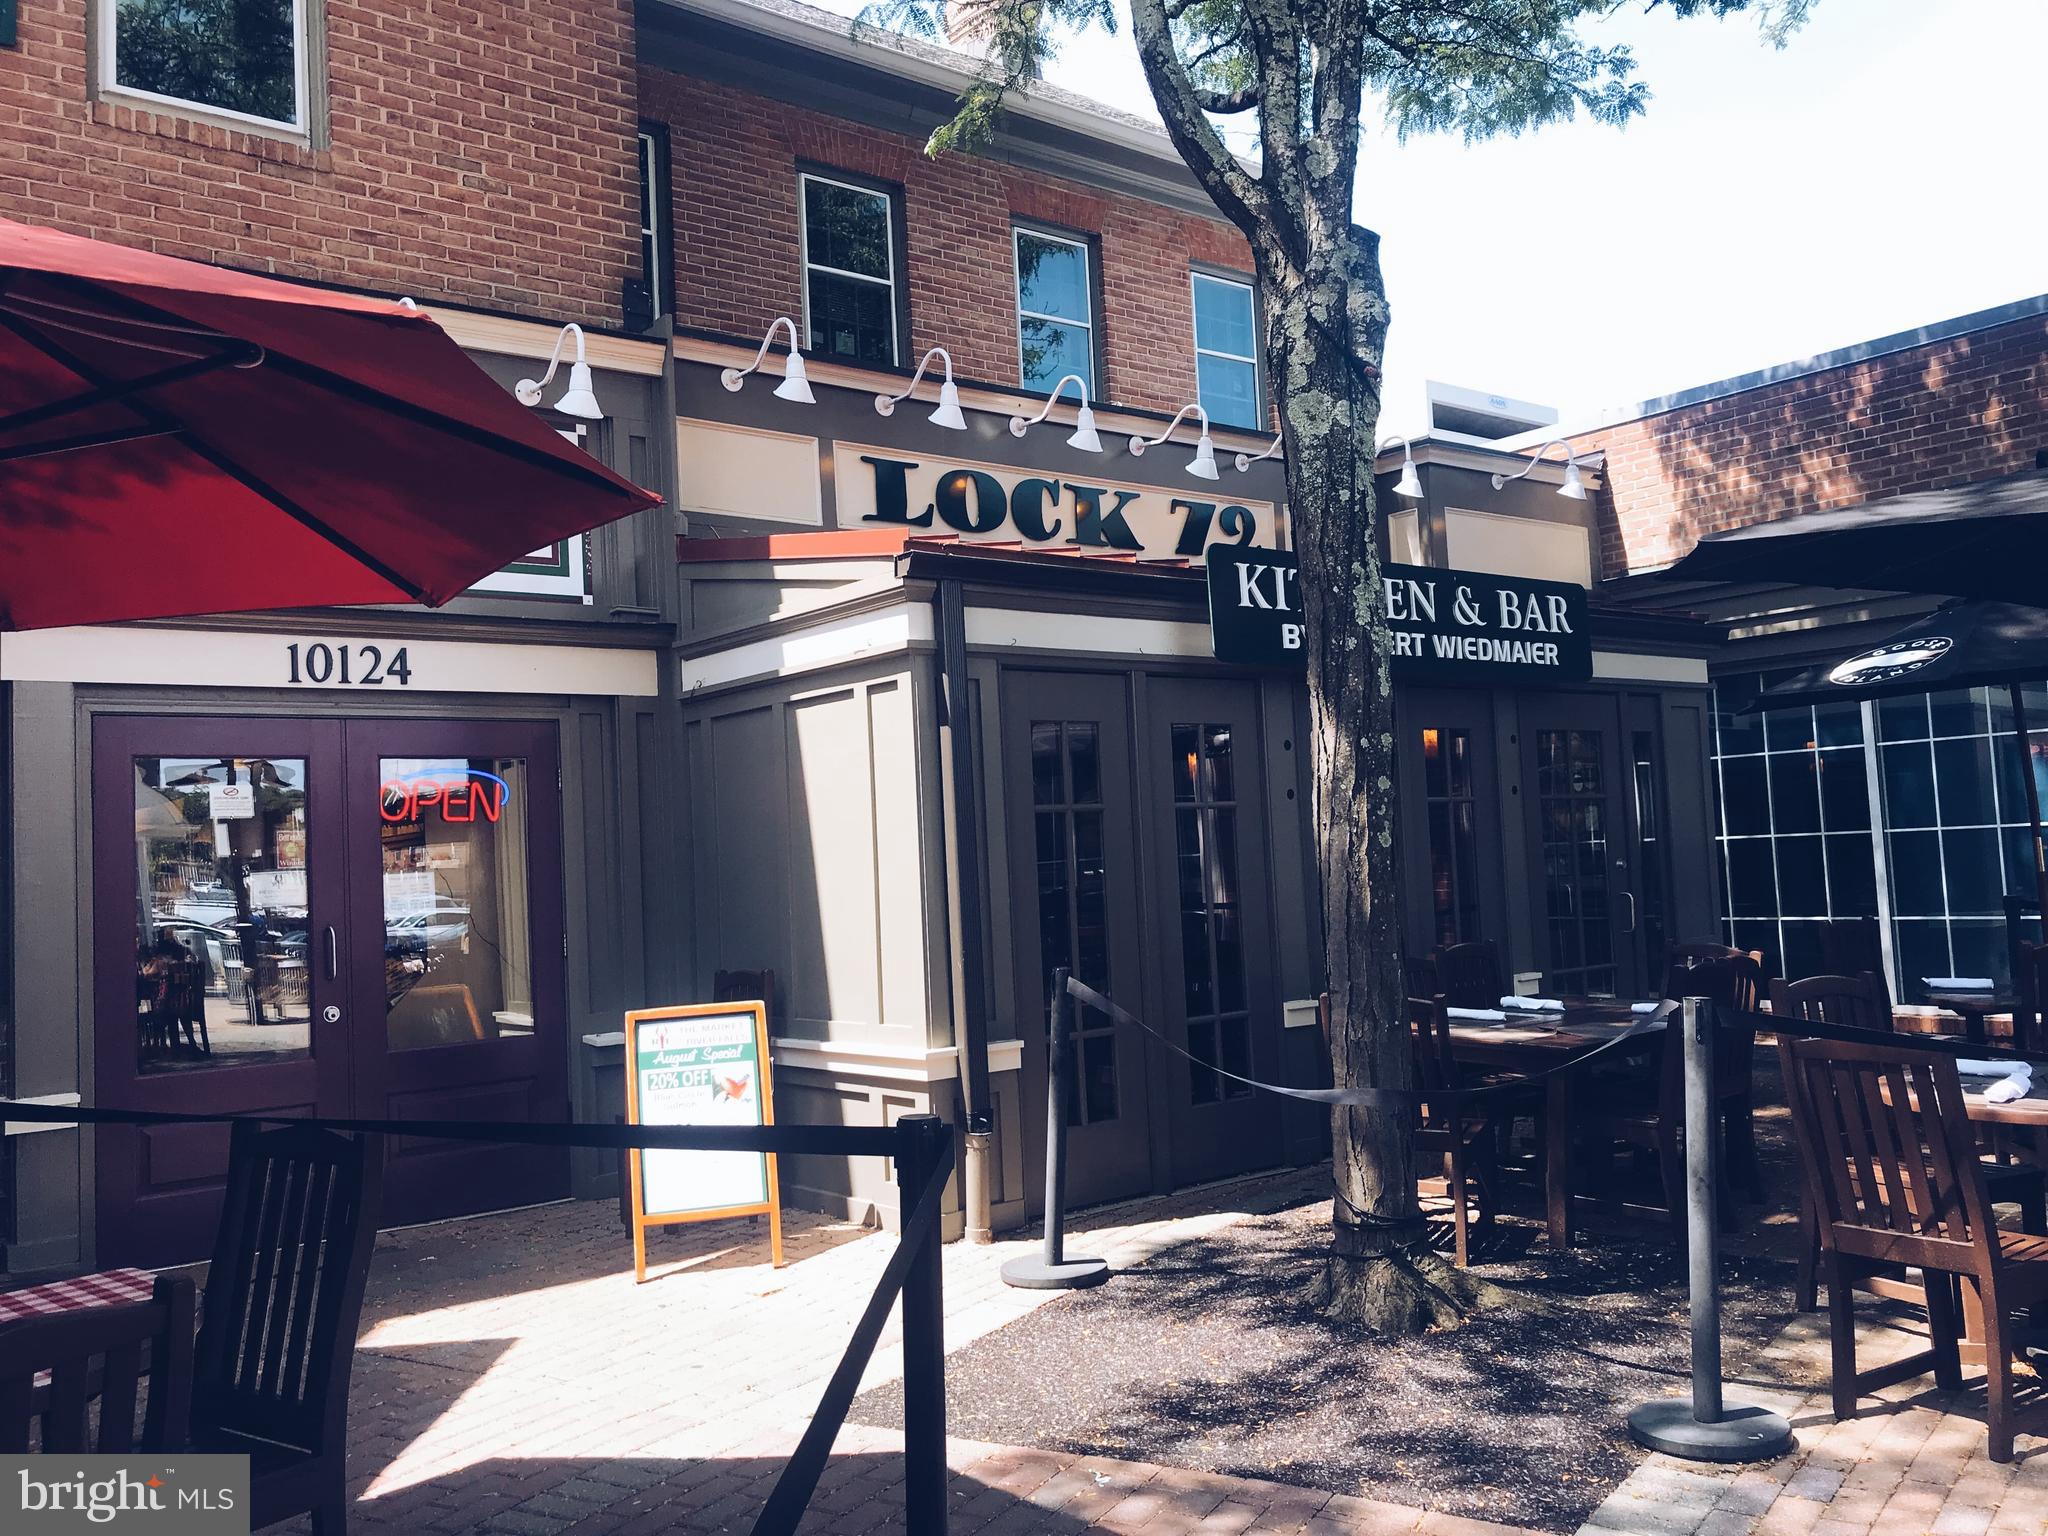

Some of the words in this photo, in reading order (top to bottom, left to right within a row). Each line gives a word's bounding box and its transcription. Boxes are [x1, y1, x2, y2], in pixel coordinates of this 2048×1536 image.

[859, 455, 1145, 551] LOCK
[1170, 498, 1256, 556] 72
[1233, 562, 1436, 623] KIEN
[1453, 585, 1487, 627] &
[1496, 590, 1574, 634] BAR
[287, 643, 412, 685] 10124
[1432, 634, 1560, 667] WIEDMAIER
[1872, 639, 1946, 657] GOOSE
[379, 779, 501, 823] OPEN
[653, 1050, 698, 1067] August
[701, 1044, 744, 1065] Special
[650, 1072, 679, 1090] 20%
[682, 1070, 709, 1087] OFF
